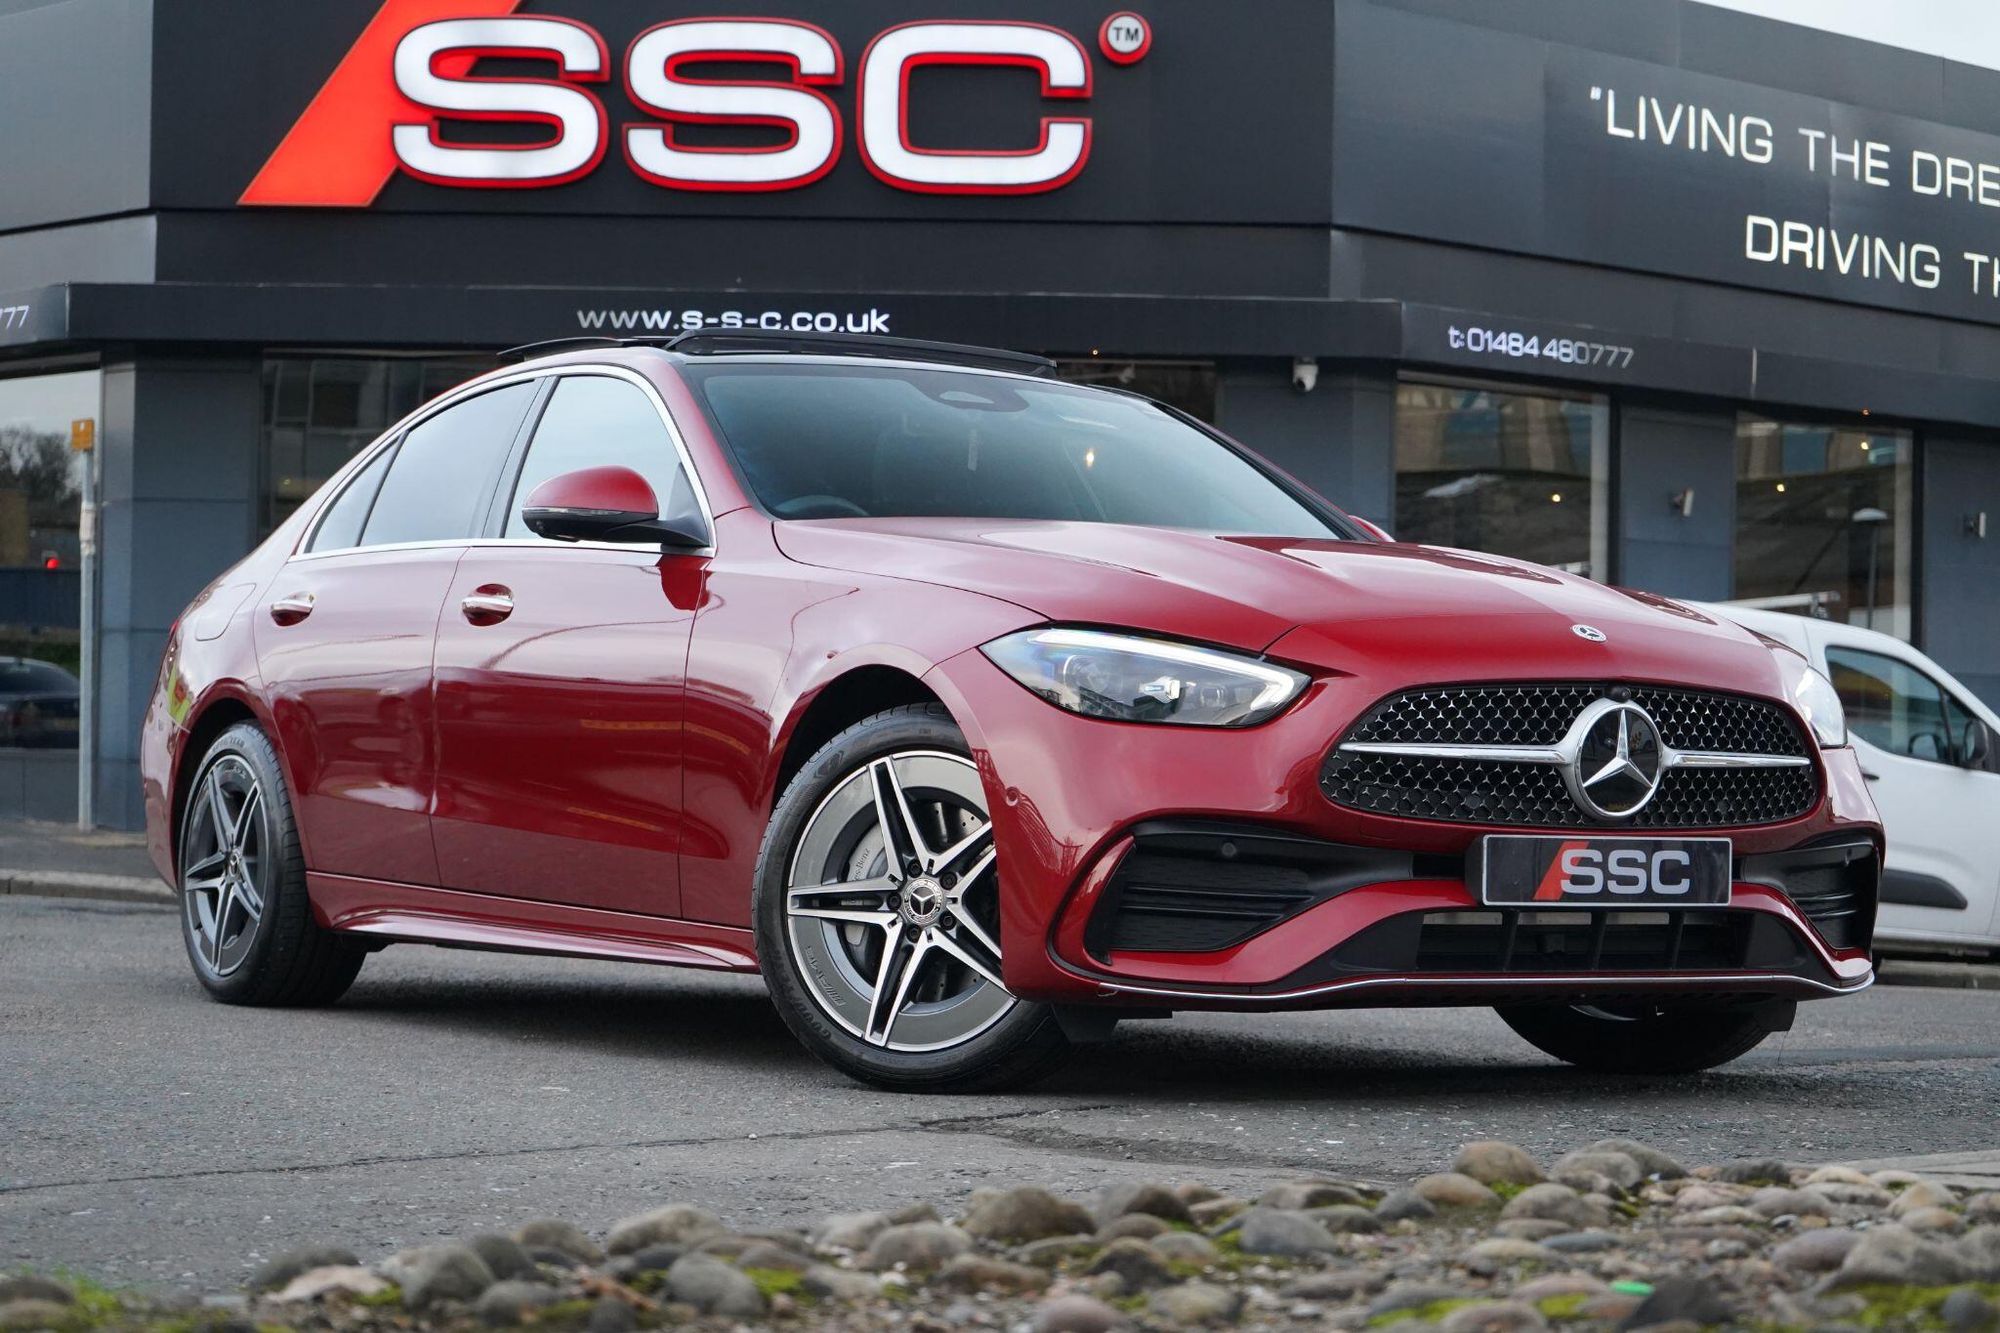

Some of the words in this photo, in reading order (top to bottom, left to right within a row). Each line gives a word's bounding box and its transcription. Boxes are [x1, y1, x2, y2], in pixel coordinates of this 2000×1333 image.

[1112, 27, 1139, 41] TM
[392, 14, 1093, 195] SSC
[1798, 127, 1890, 187] THE
[1912, 150, 2000, 207] DRE
[1745, 214, 1941, 289] DRIVING
[1963, 251, 2000, 298] T
[0, 305, 29, 329] 77
[577, 308, 890, 333] www.s-s-c.co.uk
[1542, 338, 1634, 369] 480777
[1560, 848, 1691, 895] SSC
